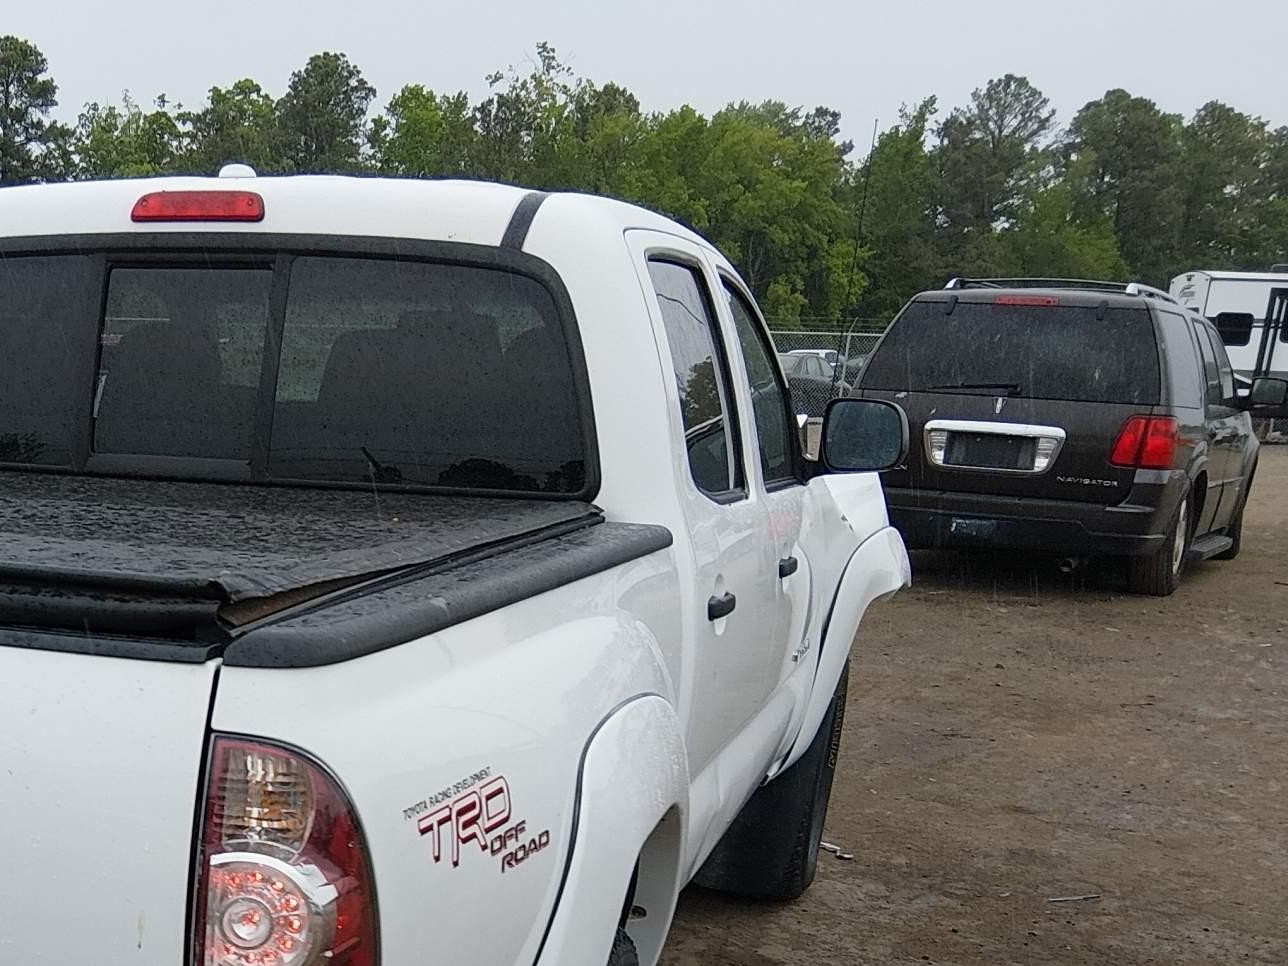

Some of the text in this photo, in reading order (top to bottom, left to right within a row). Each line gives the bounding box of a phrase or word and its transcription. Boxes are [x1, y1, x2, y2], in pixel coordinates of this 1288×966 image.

[1055, 475, 1119, 488] NAVIGATOR
[418, 776, 511, 868] TRD
[490, 819, 527, 857] OFF
[501, 829, 550, 874] ROAD
